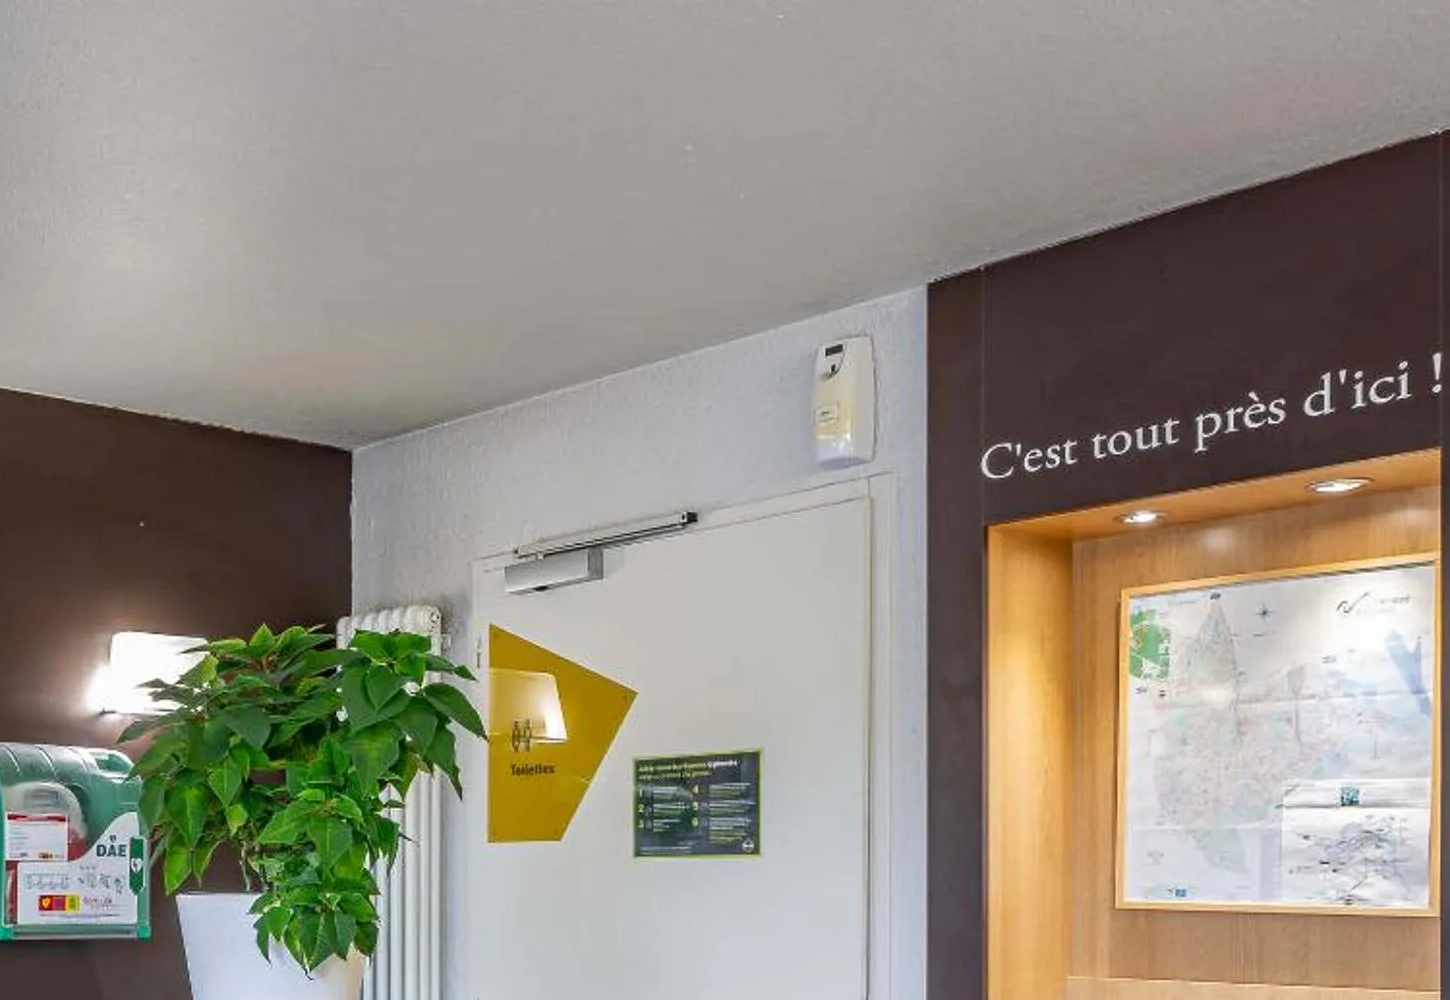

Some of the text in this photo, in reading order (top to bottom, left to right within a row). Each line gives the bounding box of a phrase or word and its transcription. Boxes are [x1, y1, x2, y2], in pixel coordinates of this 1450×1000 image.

[979, 438, 1078, 480] C'est
[1091, 415, 1180, 461] tout
[1193, 391, 1288, 454] près
[1302, 359, 1413, 418] d'ici
[511, 764, 555, 776] Toilettes
[96, 844, 127, 857] DAE
